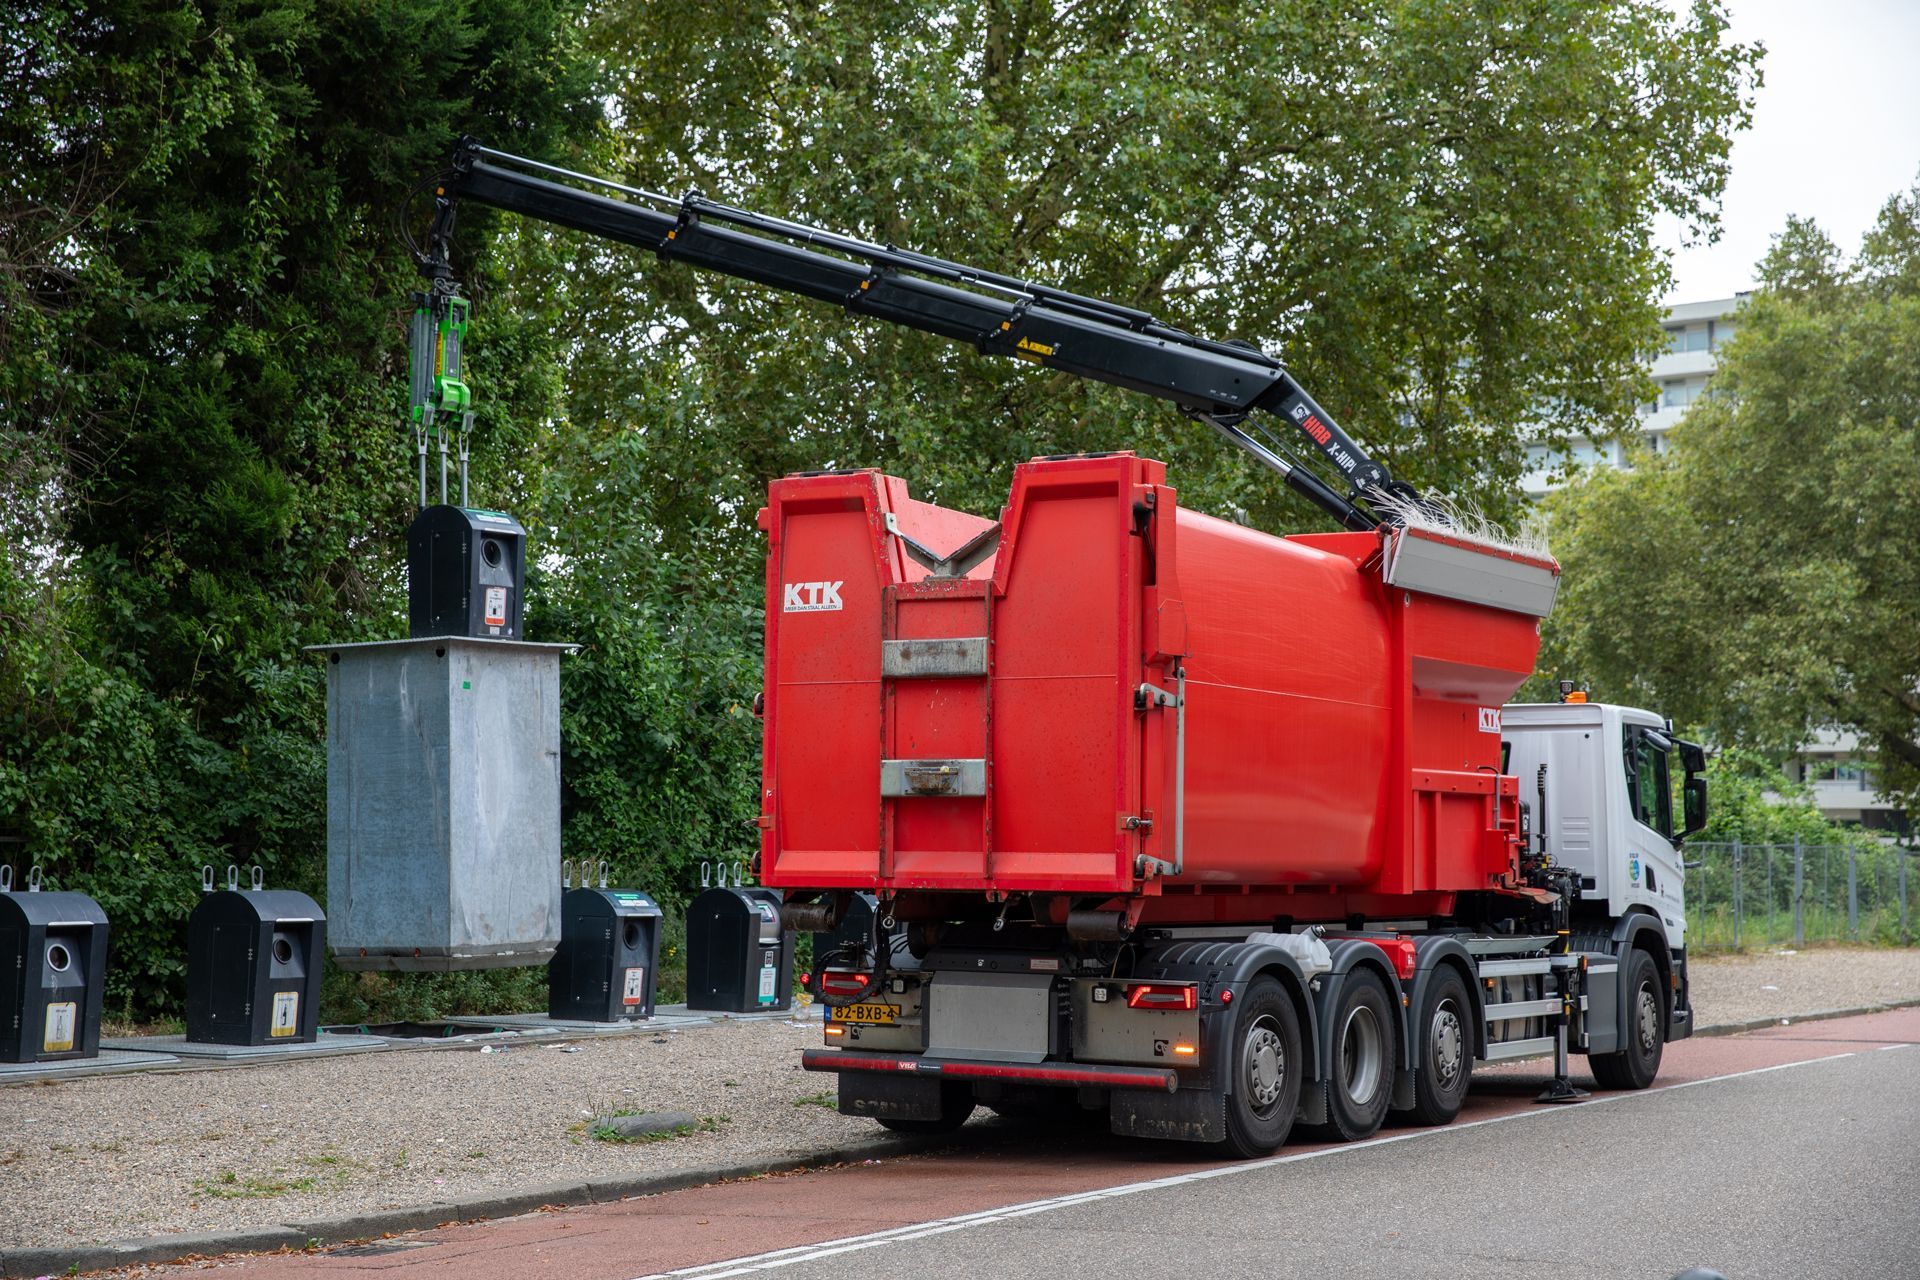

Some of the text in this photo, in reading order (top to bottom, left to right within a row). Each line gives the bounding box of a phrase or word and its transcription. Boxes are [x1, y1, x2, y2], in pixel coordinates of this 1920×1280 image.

[1302, 415, 1357, 474] HIAB X-HIP
[784, 581, 843, 606] KTK
[1479, 707, 1501, 728] KTK
[835, 1005, 895, 1020] 82-BXB-4
